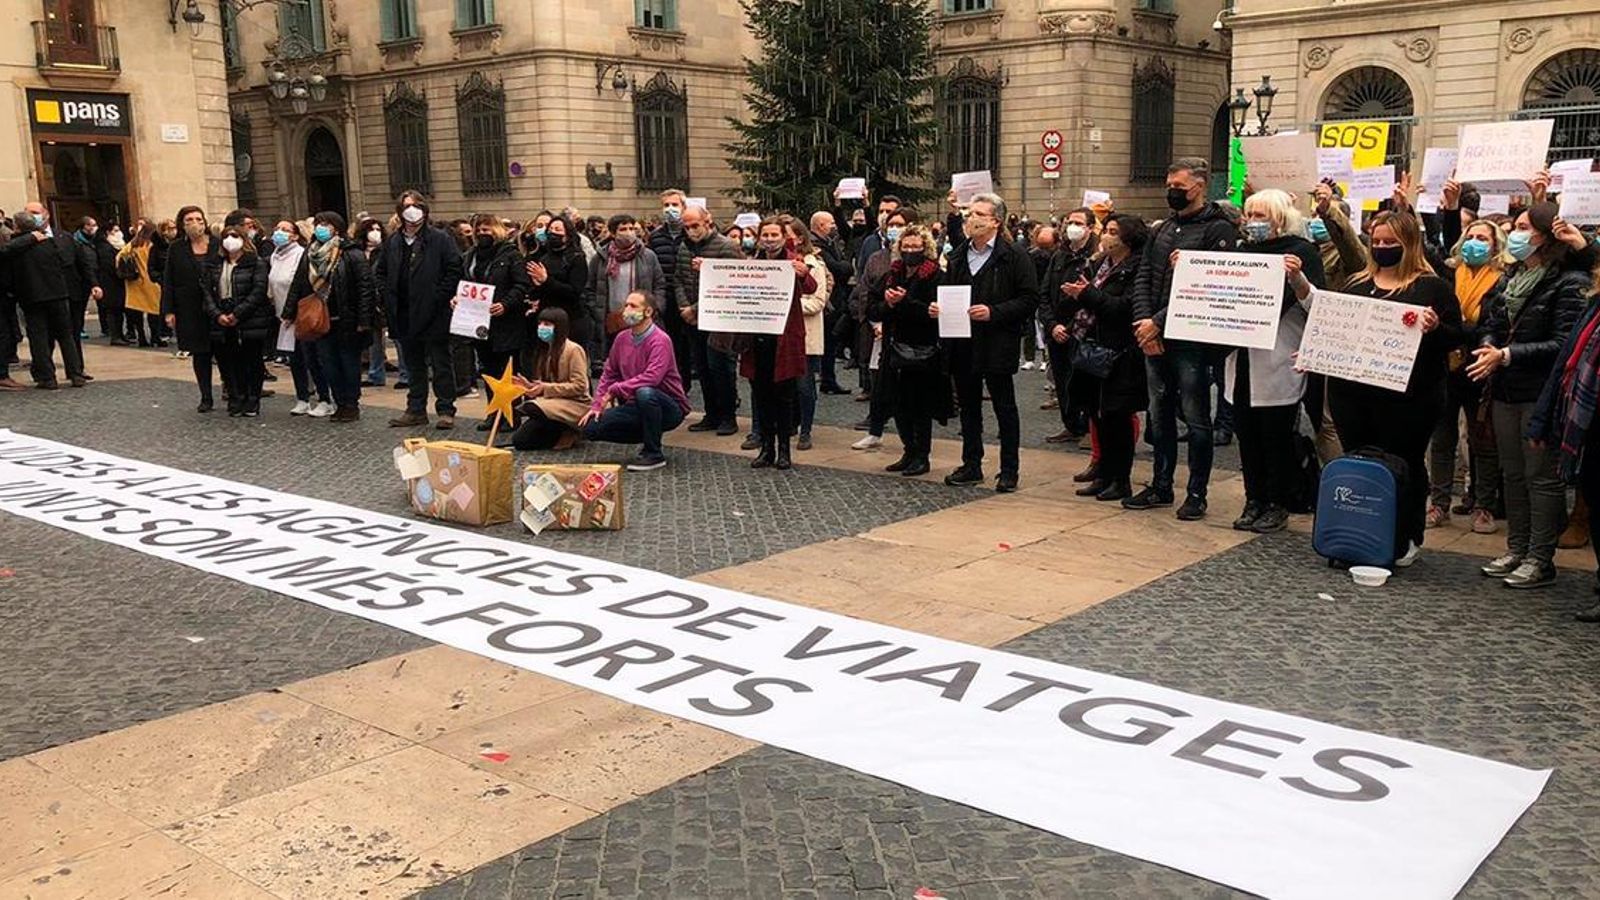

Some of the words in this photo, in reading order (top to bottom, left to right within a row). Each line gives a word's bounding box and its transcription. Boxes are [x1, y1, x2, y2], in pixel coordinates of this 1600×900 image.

[63, 101, 120, 123] pans
[1322, 125, 1382, 150] SOS
[461, 284, 489, 301] SOS
[103, 518, 297, 564] SOM
[247, 555, 464, 611] MÉS
[424, 602, 813, 718] FORTS
[91, 476, 169, 489] A
[137, 483, 271, 511] LES
[227, 506, 626, 596] AGÈNCIES
[601, 590, 785, 640] DE
[784, 626, 1413, 803] VIATGES
